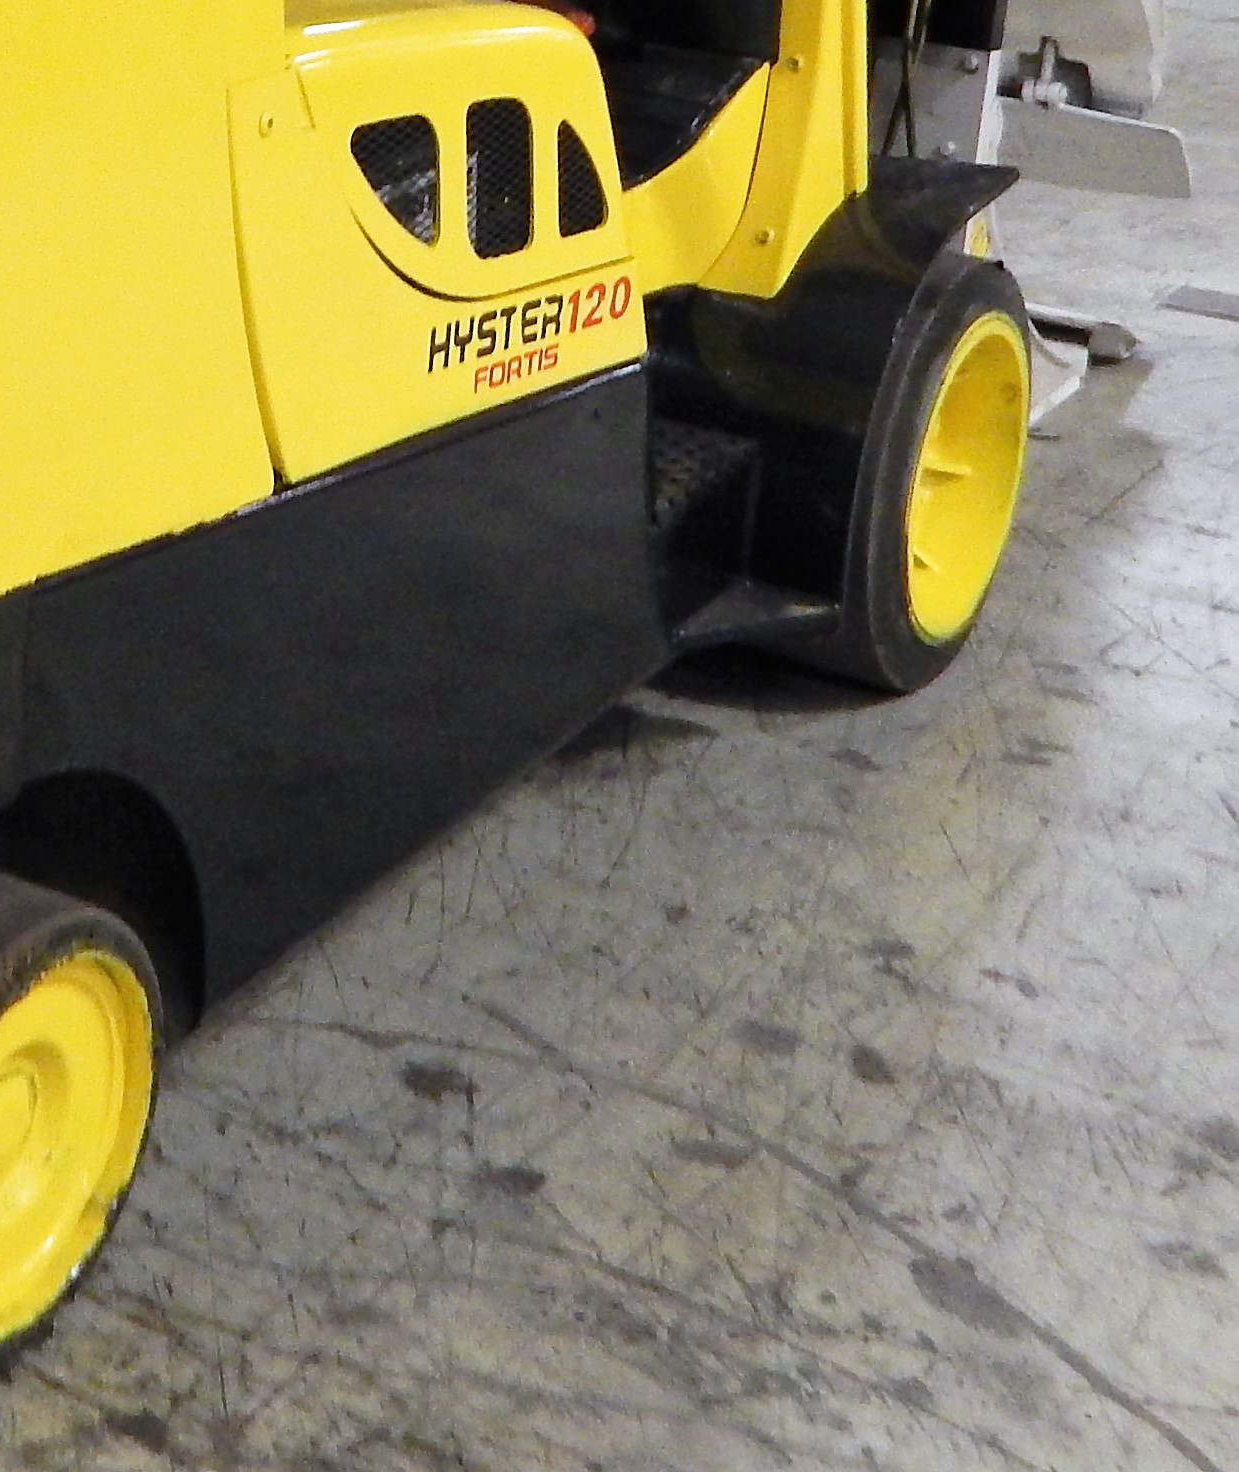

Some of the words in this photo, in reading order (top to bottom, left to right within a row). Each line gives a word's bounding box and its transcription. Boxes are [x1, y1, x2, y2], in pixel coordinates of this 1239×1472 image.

[428, 294, 563, 373] HYSTER
[568, 276, 632, 334] 120
[474, 344, 560, 393] FORTIS
